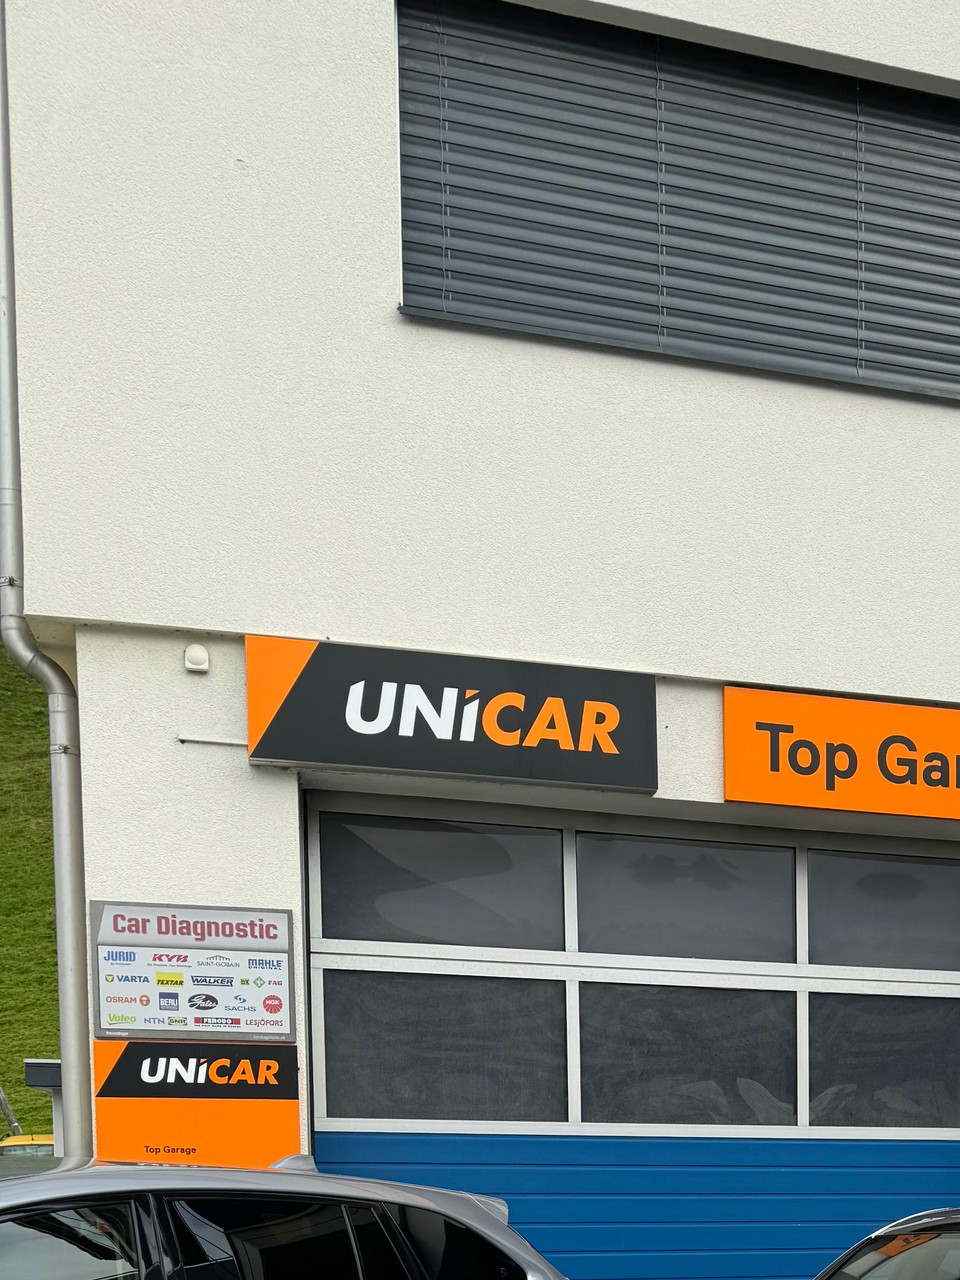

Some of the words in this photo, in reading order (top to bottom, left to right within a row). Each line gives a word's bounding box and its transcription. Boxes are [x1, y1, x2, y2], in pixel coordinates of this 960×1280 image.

[755, 721, 858, 792] Top
[112, 913, 151, 935] Car
[156, 914, 279, 942] Diagnostic
[103, 950, 136, 962] JURID
[152, 953, 189, 963] KYB
[196, 960, 240, 968] SAINT-GOBAIN
[248, 958, 283, 967] MAHLE
[116, 975, 150, 983] VARTA
[156, 979, 184, 987] TEXTAR
[191, 975, 234, 987] WALKER
[105, 995, 137, 1004] OSRAM
[160, 998, 178, 1006] BERU
[188, 995, 217, 1008] Gates
[108, 1013, 137, 1023] Valeo
[143, 1017, 165, 1025] NTN
[143, 1145, 161, 1155] Top
[163, 1145, 197, 1155] Garage
